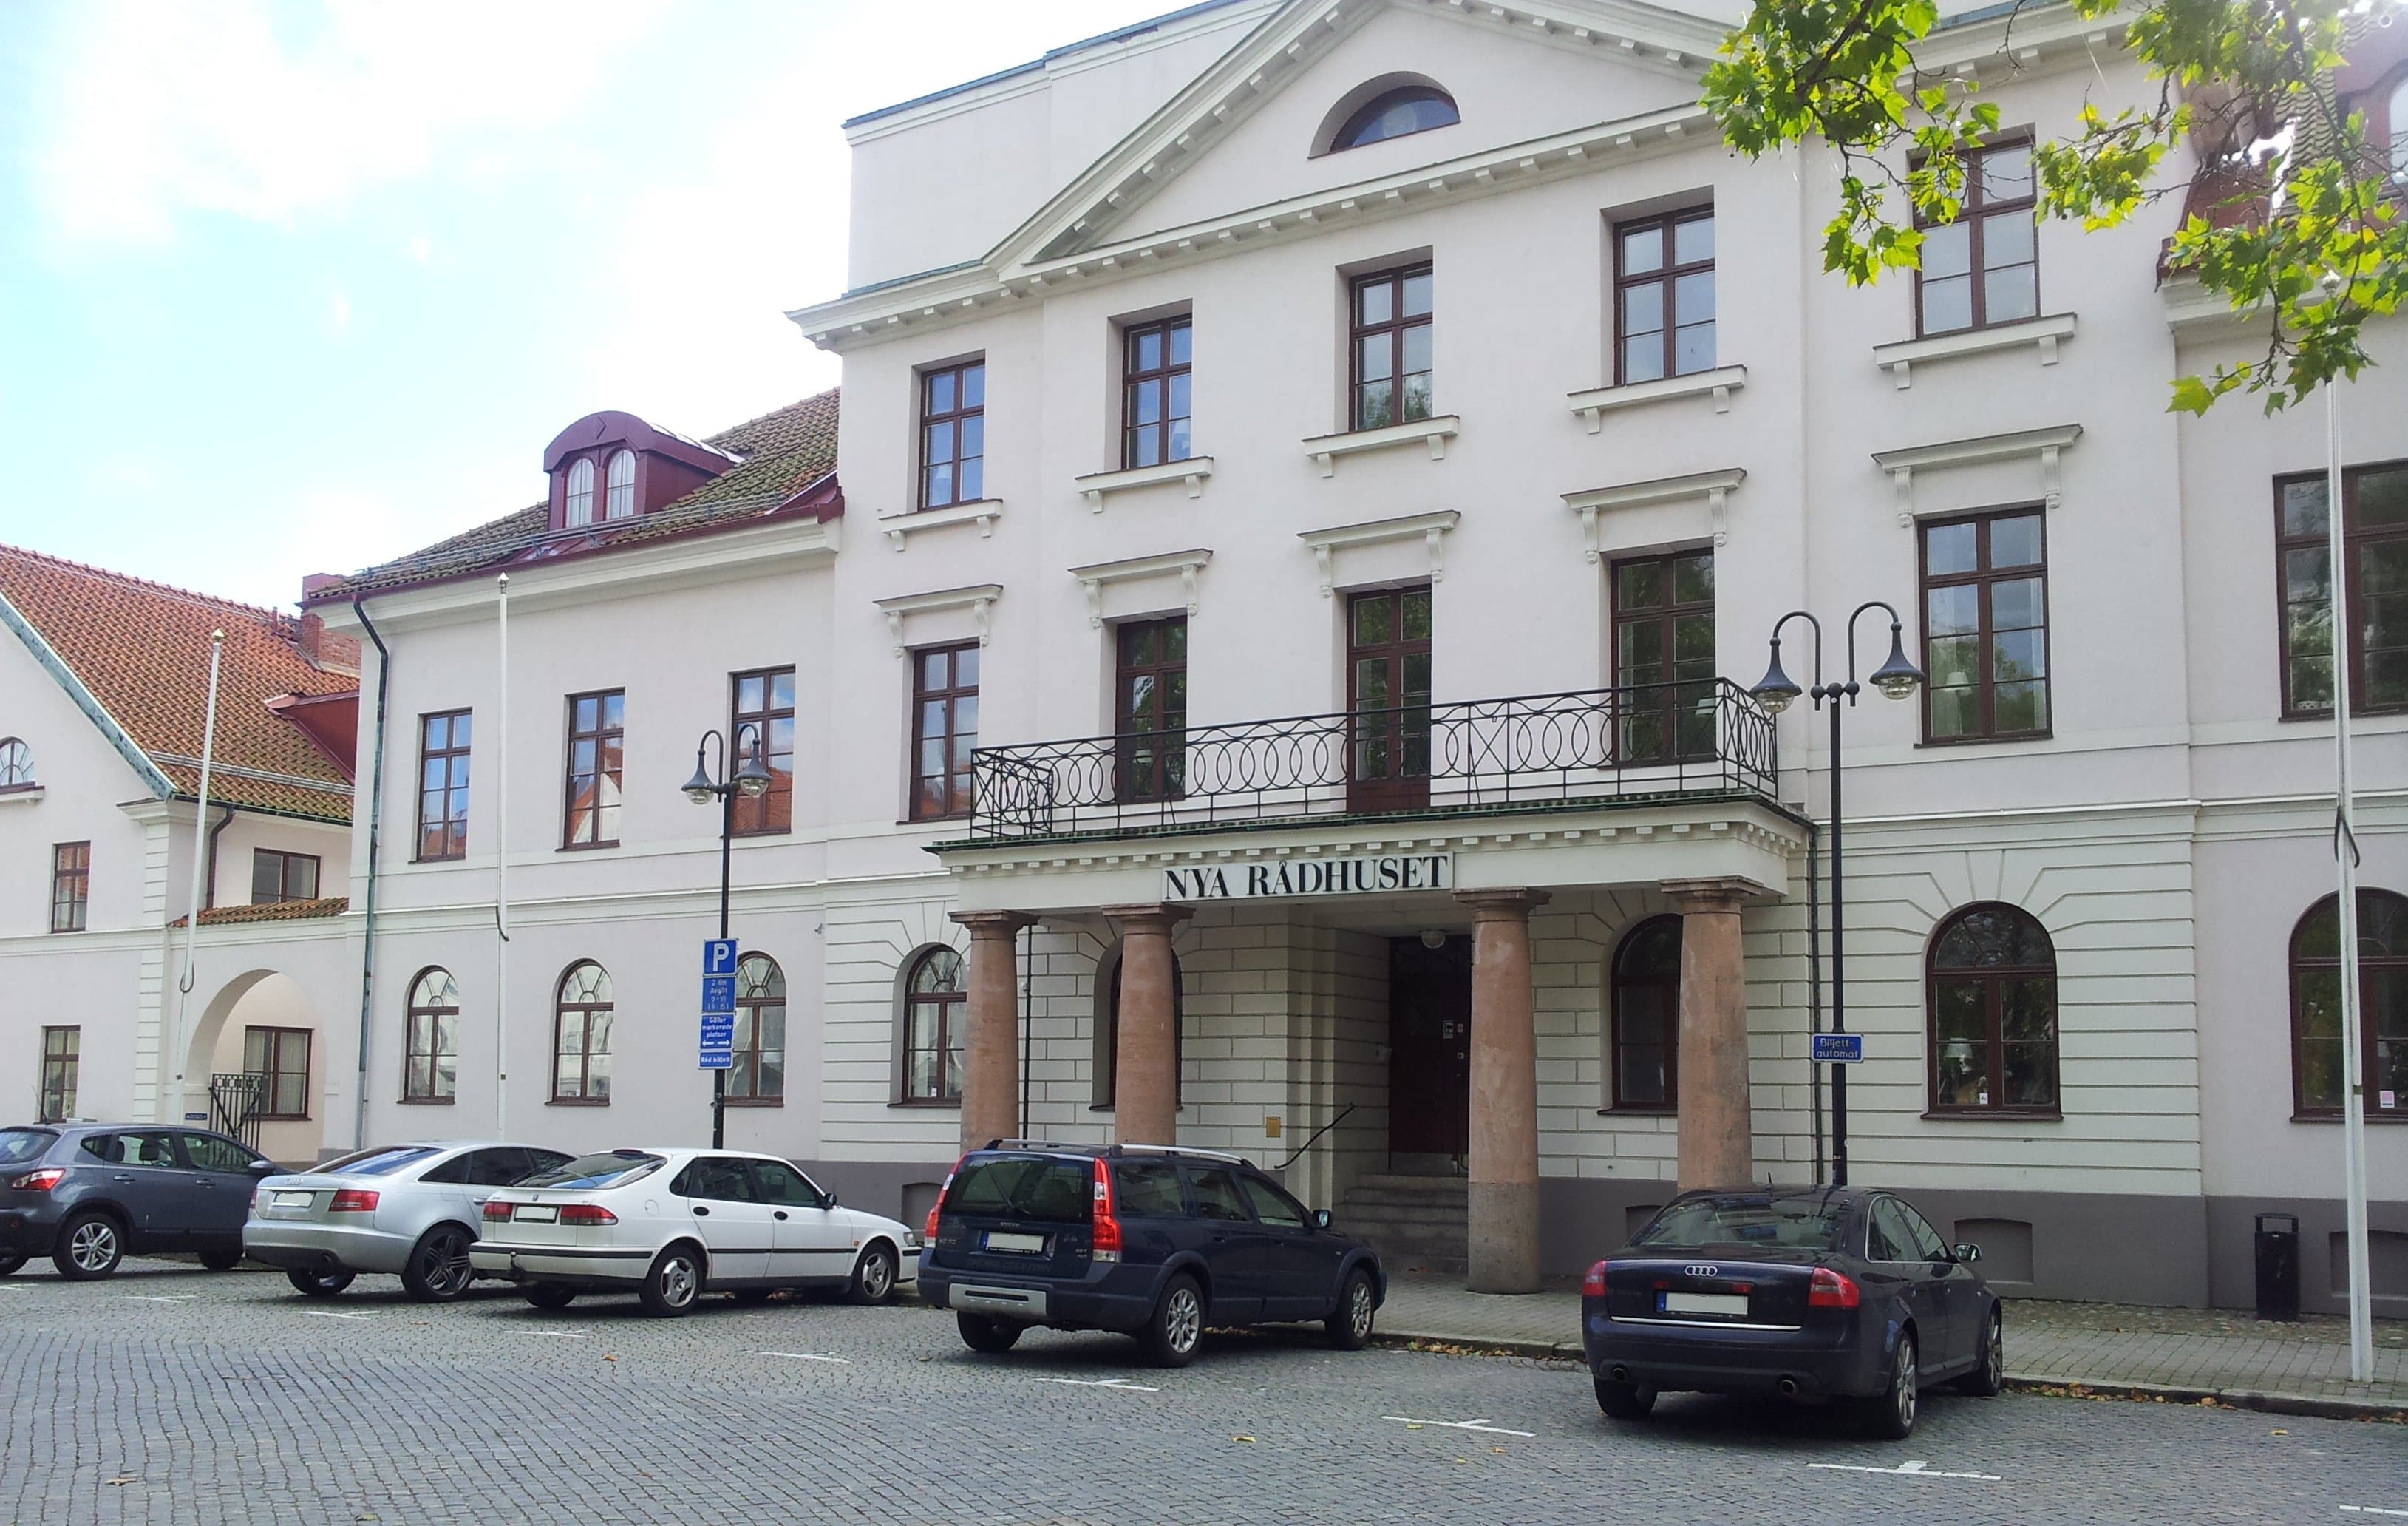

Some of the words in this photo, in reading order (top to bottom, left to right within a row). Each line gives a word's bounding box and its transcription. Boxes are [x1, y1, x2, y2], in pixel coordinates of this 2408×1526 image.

[1165, 867, 1230, 899] NYA
[1247, 855, 1448, 896] RÅDHUSET
[712, 943, 729, 971] P
[1816, 1050, 1858, 1059] automat
